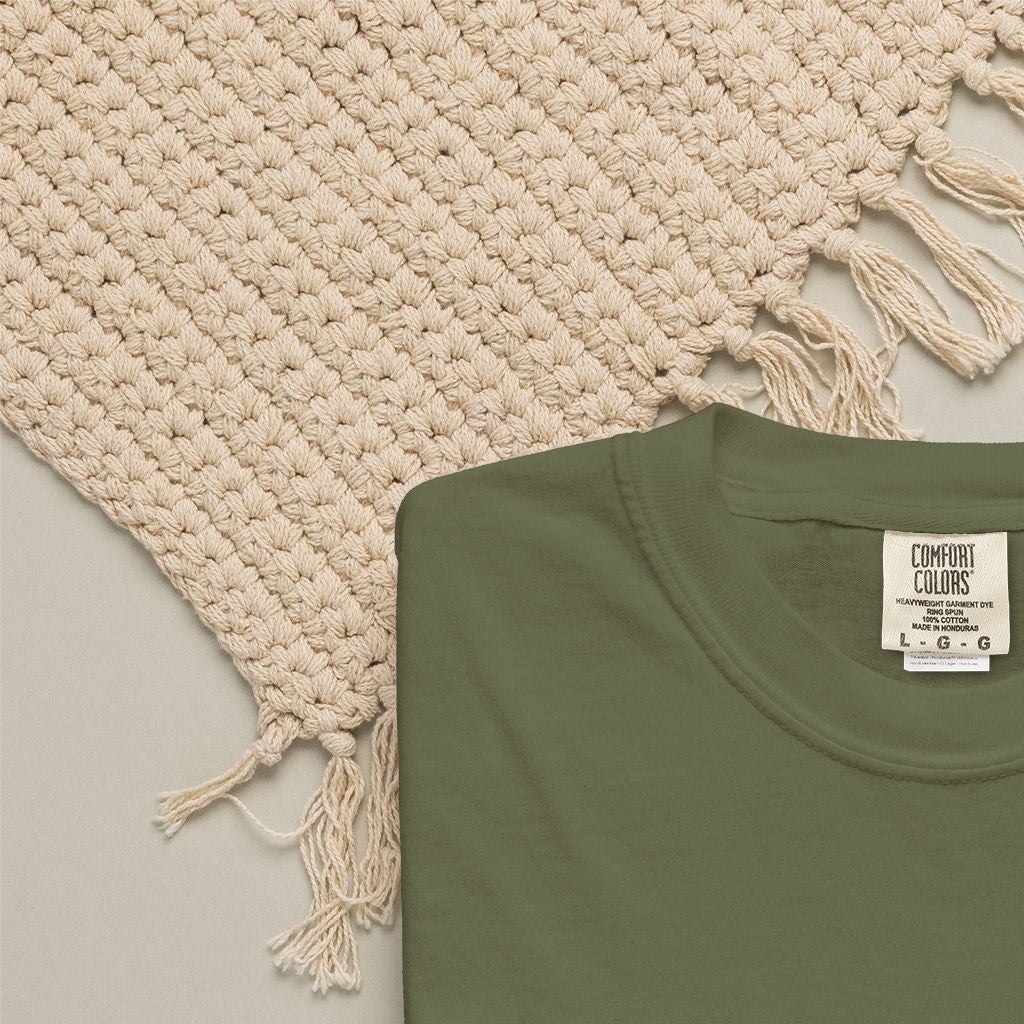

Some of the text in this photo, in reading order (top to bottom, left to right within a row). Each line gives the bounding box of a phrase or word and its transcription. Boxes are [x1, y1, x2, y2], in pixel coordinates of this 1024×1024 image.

[911, 543, 976, 569] COMFORT
[895, 598, 994, 609] HEAVYWEIGHT GARMENT DYE
[926, 608, 944, 616] RING
[922, 616, 969, 624] 100% COTTON
[912, 622, 979, 632] MADE IN HONDURAS
[900, 632, 910, 648] L
[936, 635, 950, 650] G
[977, 635, 991, 651] G
